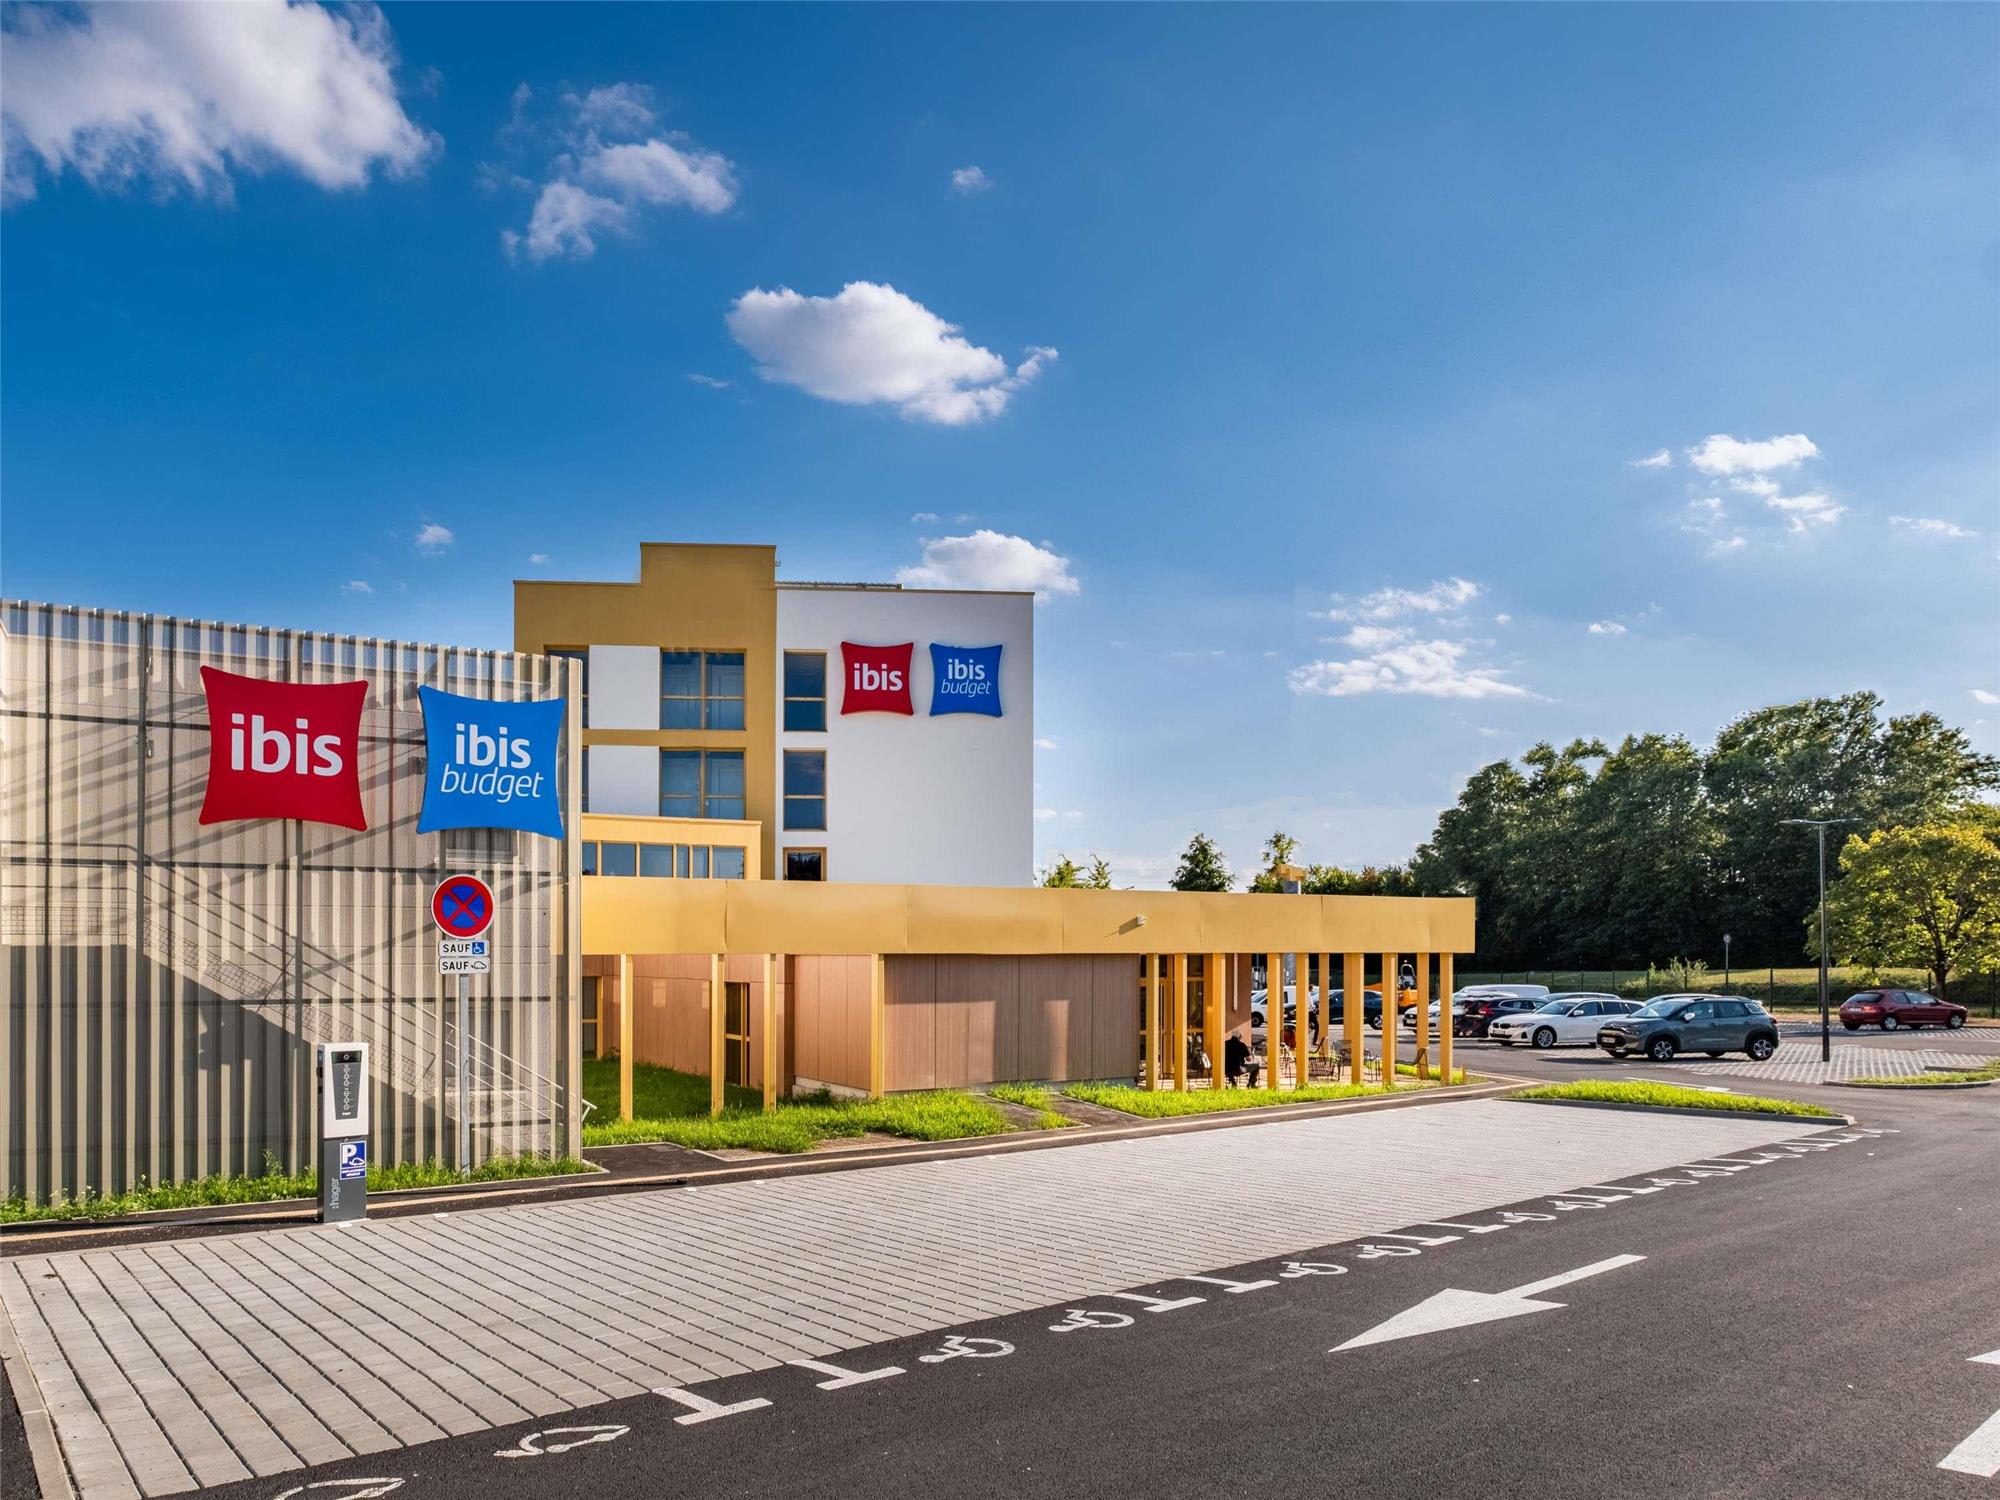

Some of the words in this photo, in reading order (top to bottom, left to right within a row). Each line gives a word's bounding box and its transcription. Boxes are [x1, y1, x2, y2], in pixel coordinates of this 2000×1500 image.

[854, 662, 903, 691] ibis
[948, 659, 985, 680] ibis
[941, 679, 992, 698] budget
[231, 712, 343, 776] ibis
[455, 723, 531, 769] ibis
[440, 766, 544, 803] budget
[443, 944, 471, 953] SAUF
[442, 961, 469, 970] SAUF
[342, 1144, 357, 1164] P
